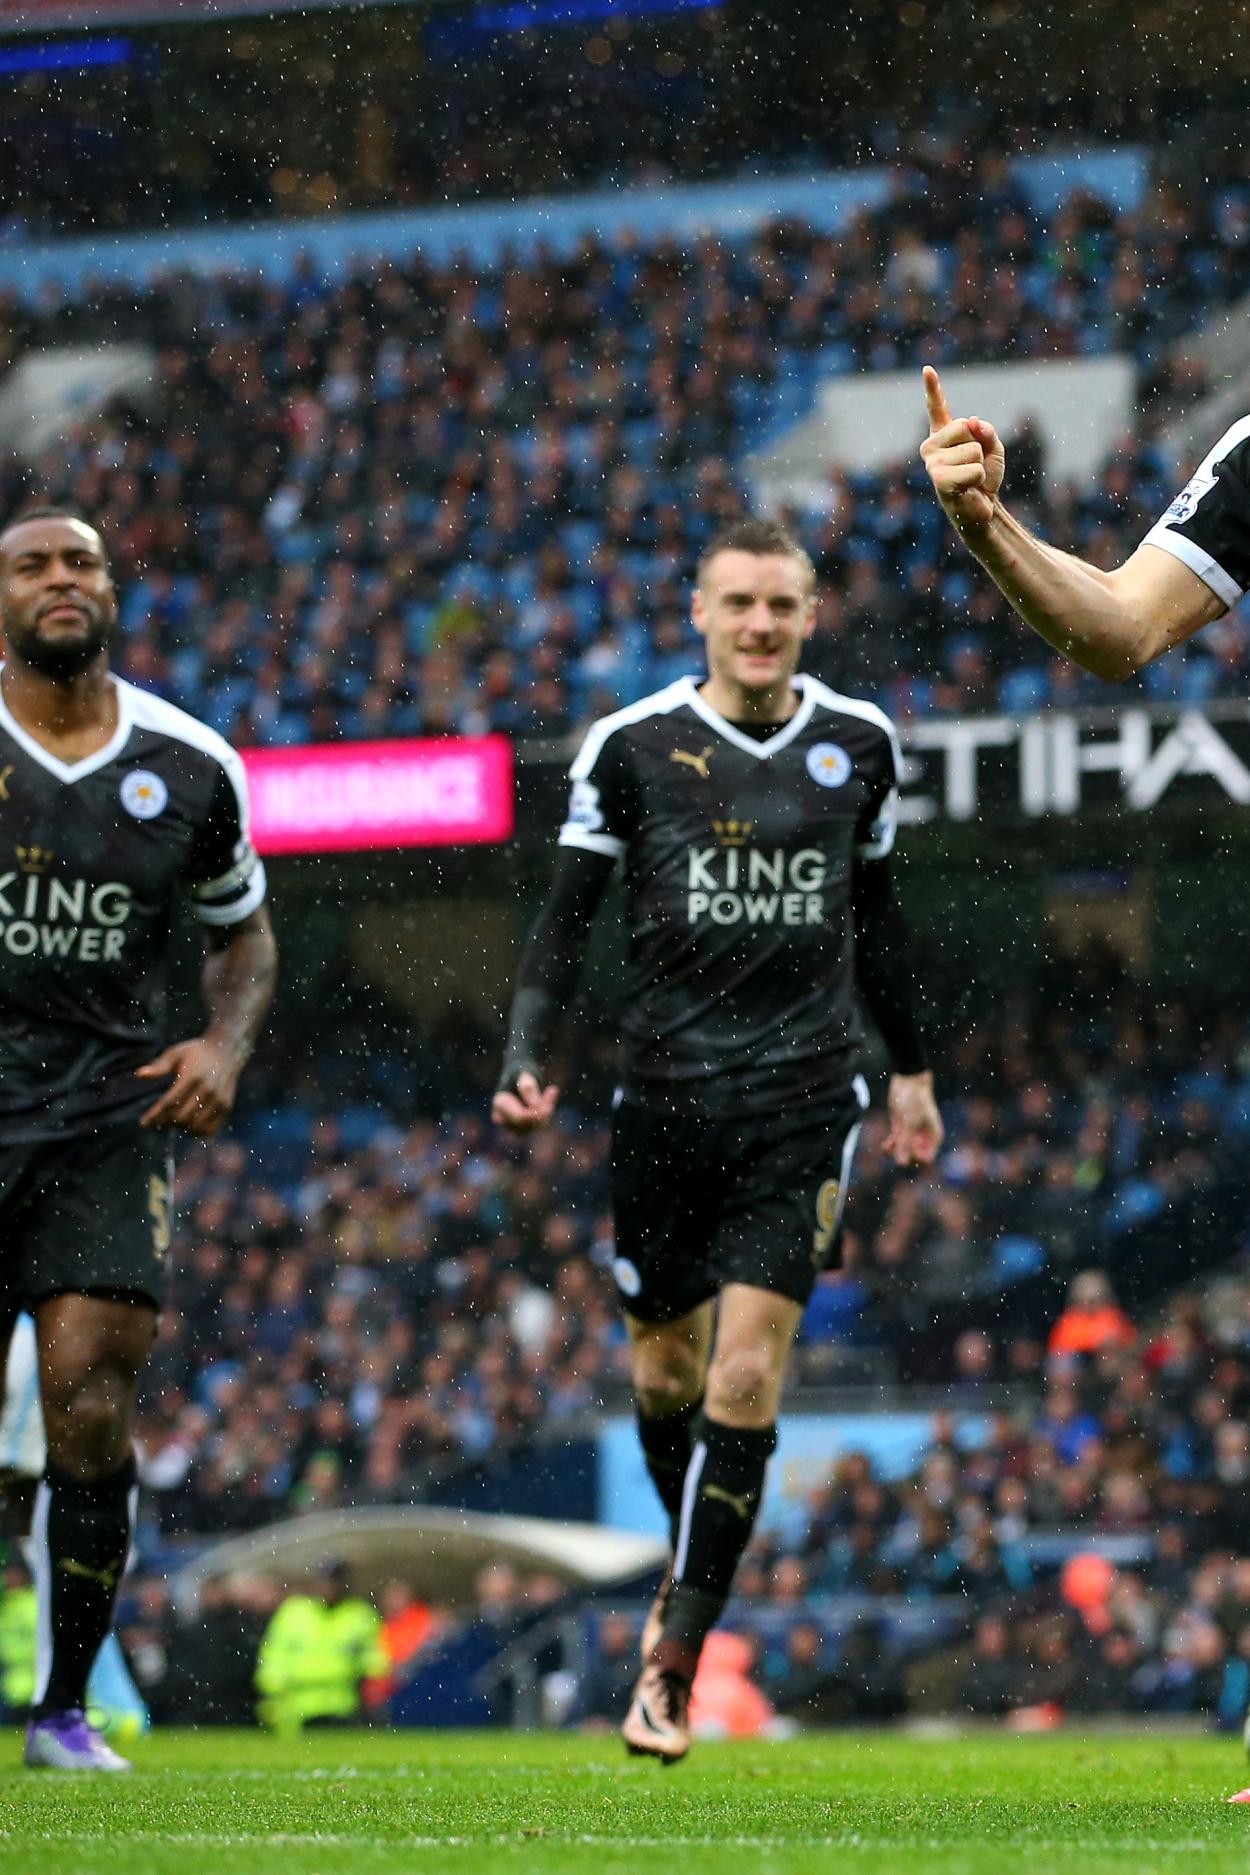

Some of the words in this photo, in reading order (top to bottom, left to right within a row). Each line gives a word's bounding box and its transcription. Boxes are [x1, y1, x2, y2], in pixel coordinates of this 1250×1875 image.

[688, 847, 827, 891] KING
[688, 891, 825, 925] POWER
[0, 919, 127, 962] OWER
